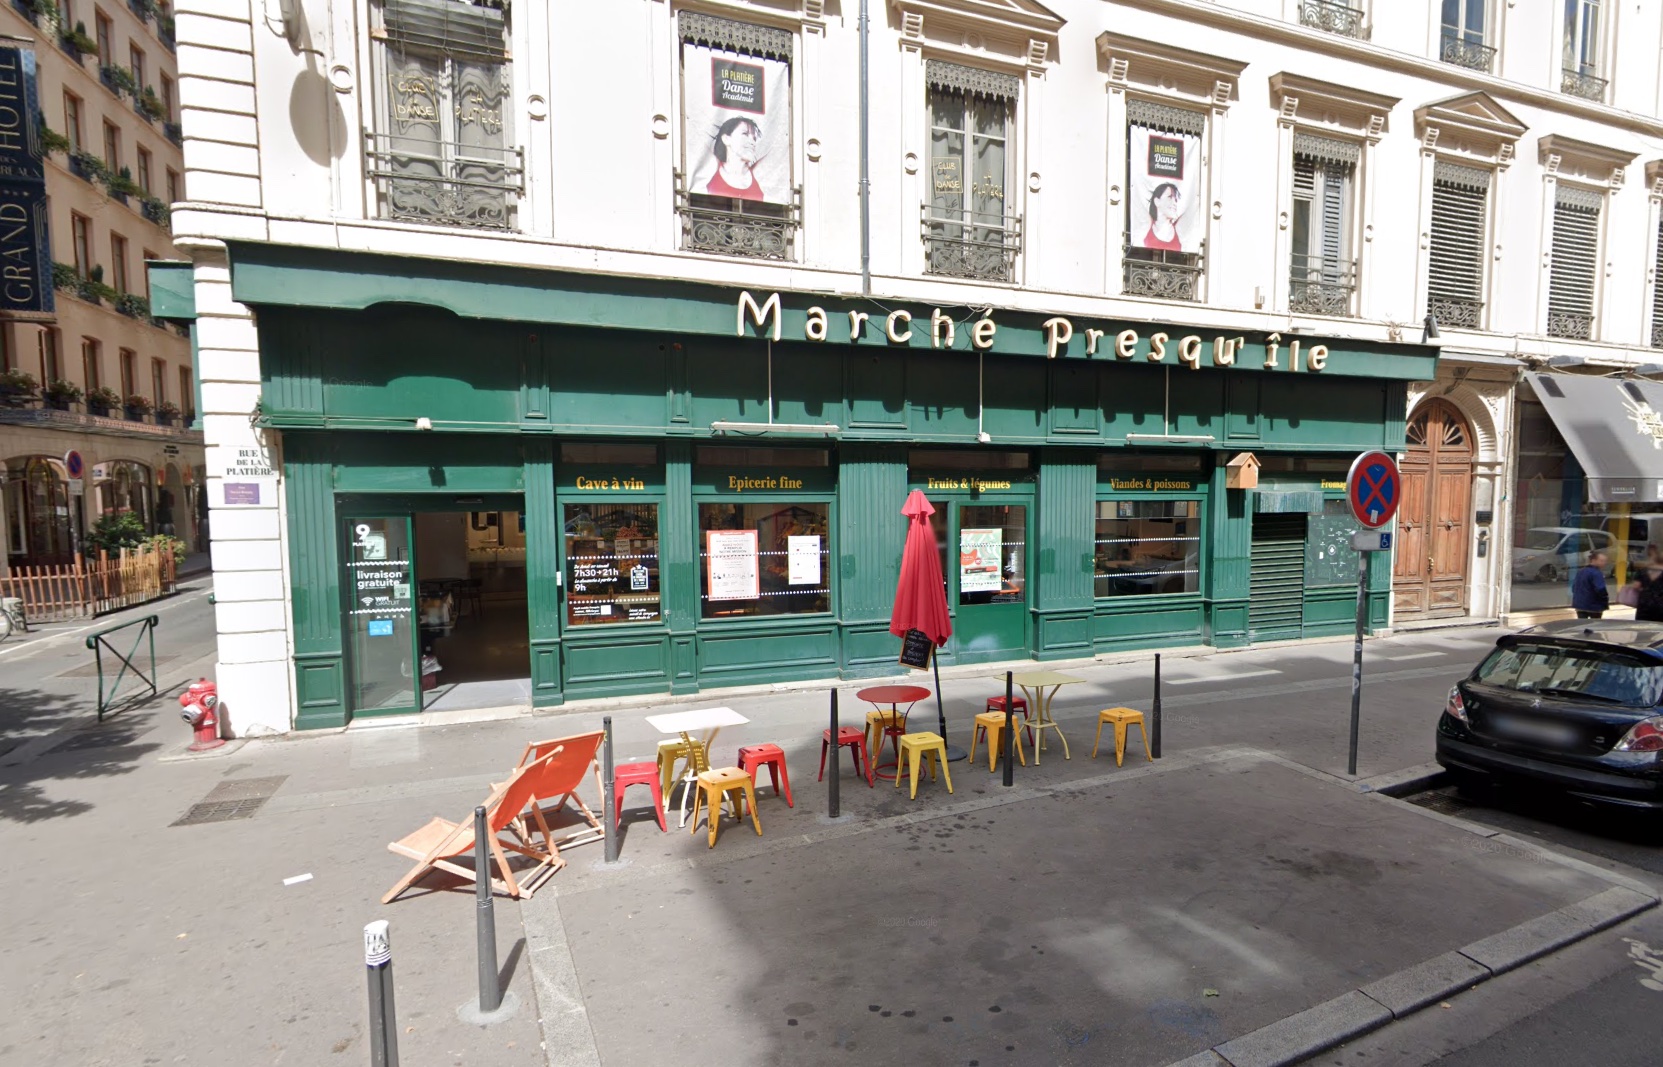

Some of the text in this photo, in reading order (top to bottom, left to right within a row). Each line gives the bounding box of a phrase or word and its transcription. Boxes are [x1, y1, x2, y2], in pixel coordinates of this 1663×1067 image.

[721, 69, 755, 84] LA PLATIÈRE
[721, 79, 755, 95] Danse
[722, 91, 754, 104] Académie
[397, 104, 435, 116] DANSE
[938, 161, 956, 170] CLUB
[1154, 153, 1178, 165] Danse
[936, 180, 960, 189] DANSE
[0, 203, 33, 303] GRAND
[737, 290, 1328, 371] Marché Presqu'île
[226, 466, 274, 476] PLATIÈRE
[576, 476, 645, 490] Cave à vin
[728, 476, 802, 492] Epicerie fine
[928, 477, 1011, 492] Fruits & légumes
[1110, 478, 1190, 492] Viandes & poissons
[355, 523, 371, 540] 9
[357, 570, 403, 580] livraison
[574, 568, 619, 577] 7h30 21h
[357, 577, 401, 590] gratuite
[575, 583, 587, 592] 9h
